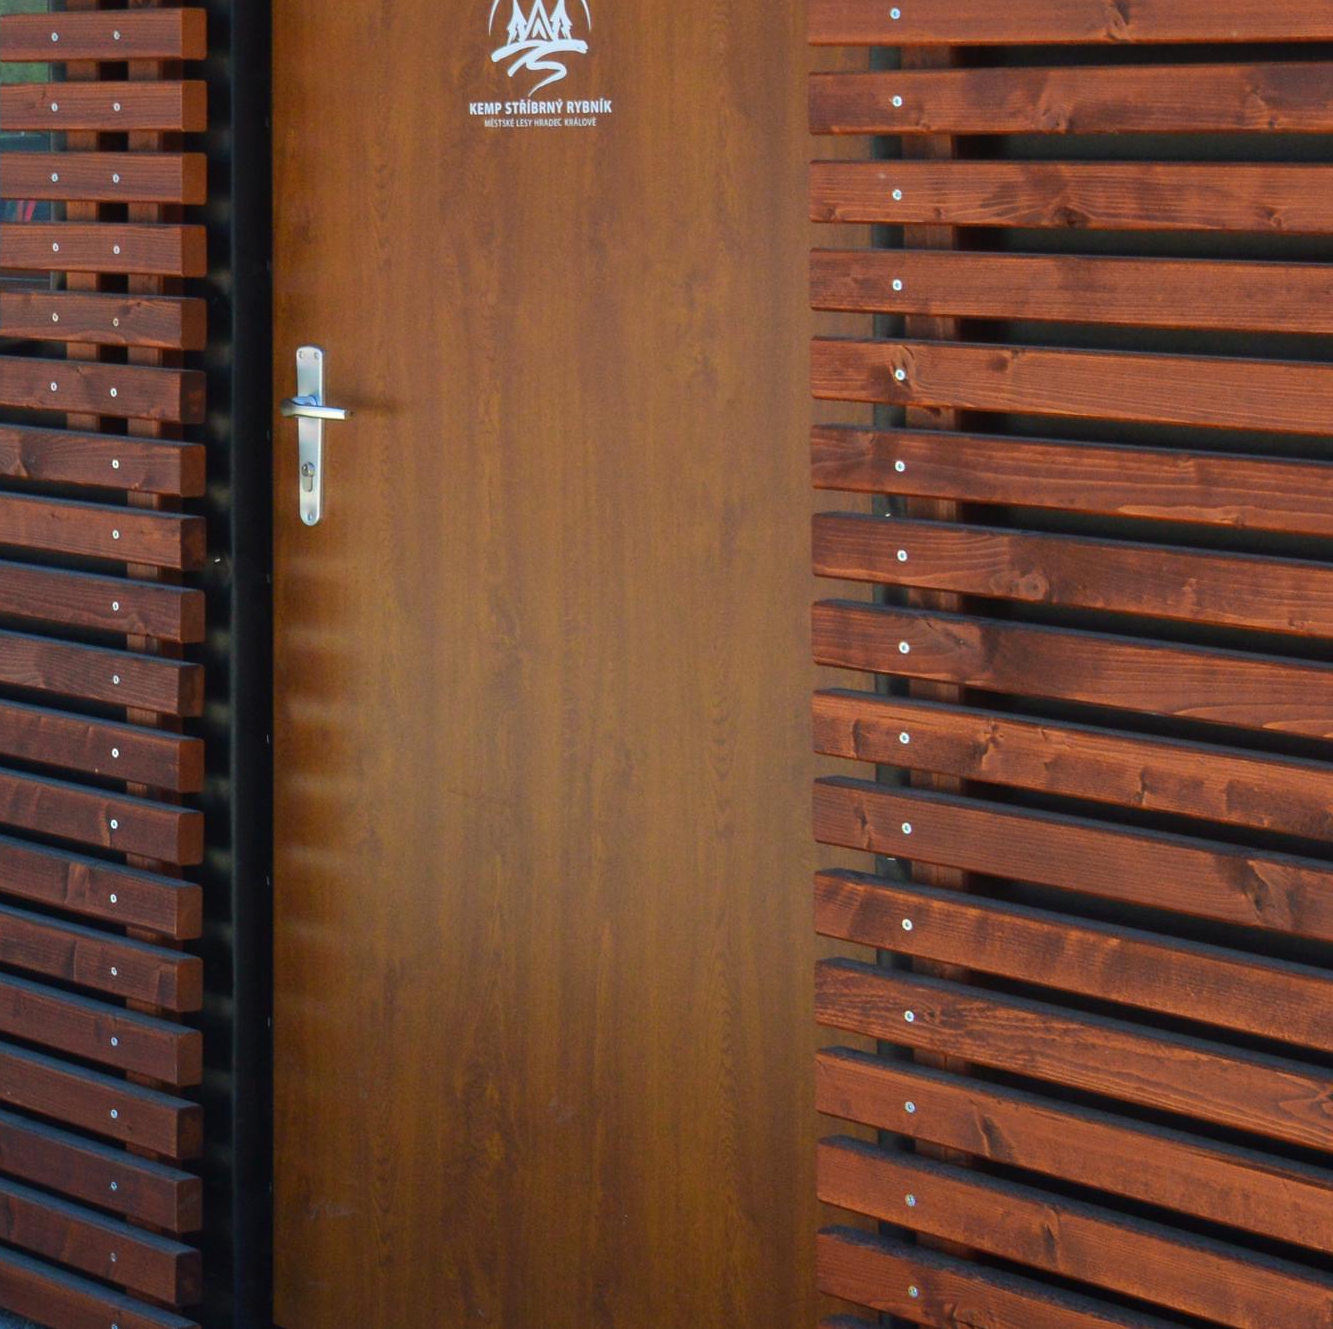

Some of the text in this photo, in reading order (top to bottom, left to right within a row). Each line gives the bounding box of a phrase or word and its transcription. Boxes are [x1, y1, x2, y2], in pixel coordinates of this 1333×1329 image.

[469, 98, 613, 115] KEMP STŘÍBRNÝ RYBNÍK
[516, 118, 533, 128] LESY
[534, 117, 562, 127] HRADEC
[564, 116, 597, 127] KRÁLOVÉ
